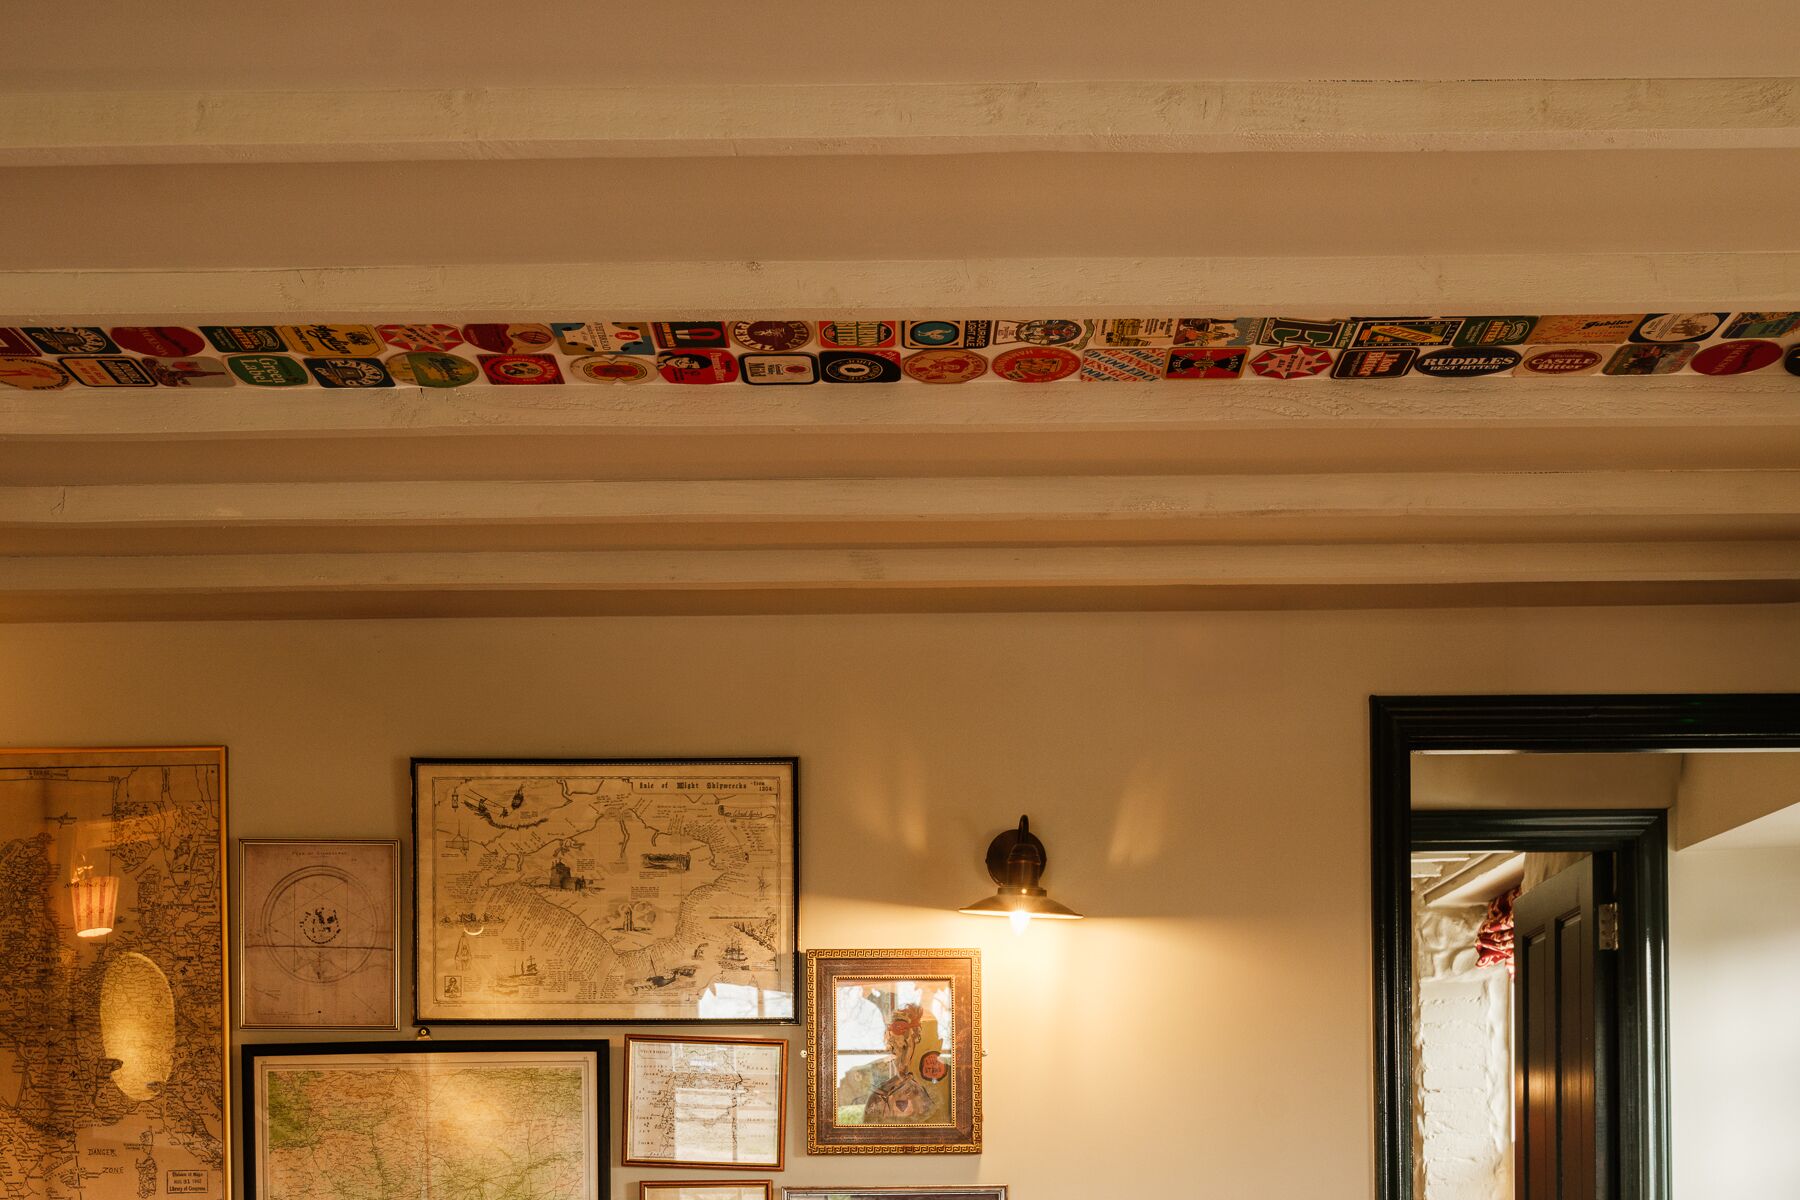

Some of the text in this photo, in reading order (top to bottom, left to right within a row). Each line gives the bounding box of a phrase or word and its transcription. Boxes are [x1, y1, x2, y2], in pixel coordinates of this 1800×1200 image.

[1422, 357, 1515, 366] RUDDLES
[1531, 358, 1595, 366] CASTLE
[240, 359, 275, 383] Label
[259, 358, 286, 384] Green
[87, 1148, 118, 1157] DANGER
[102, 1166, 124, 1175] ZONE
